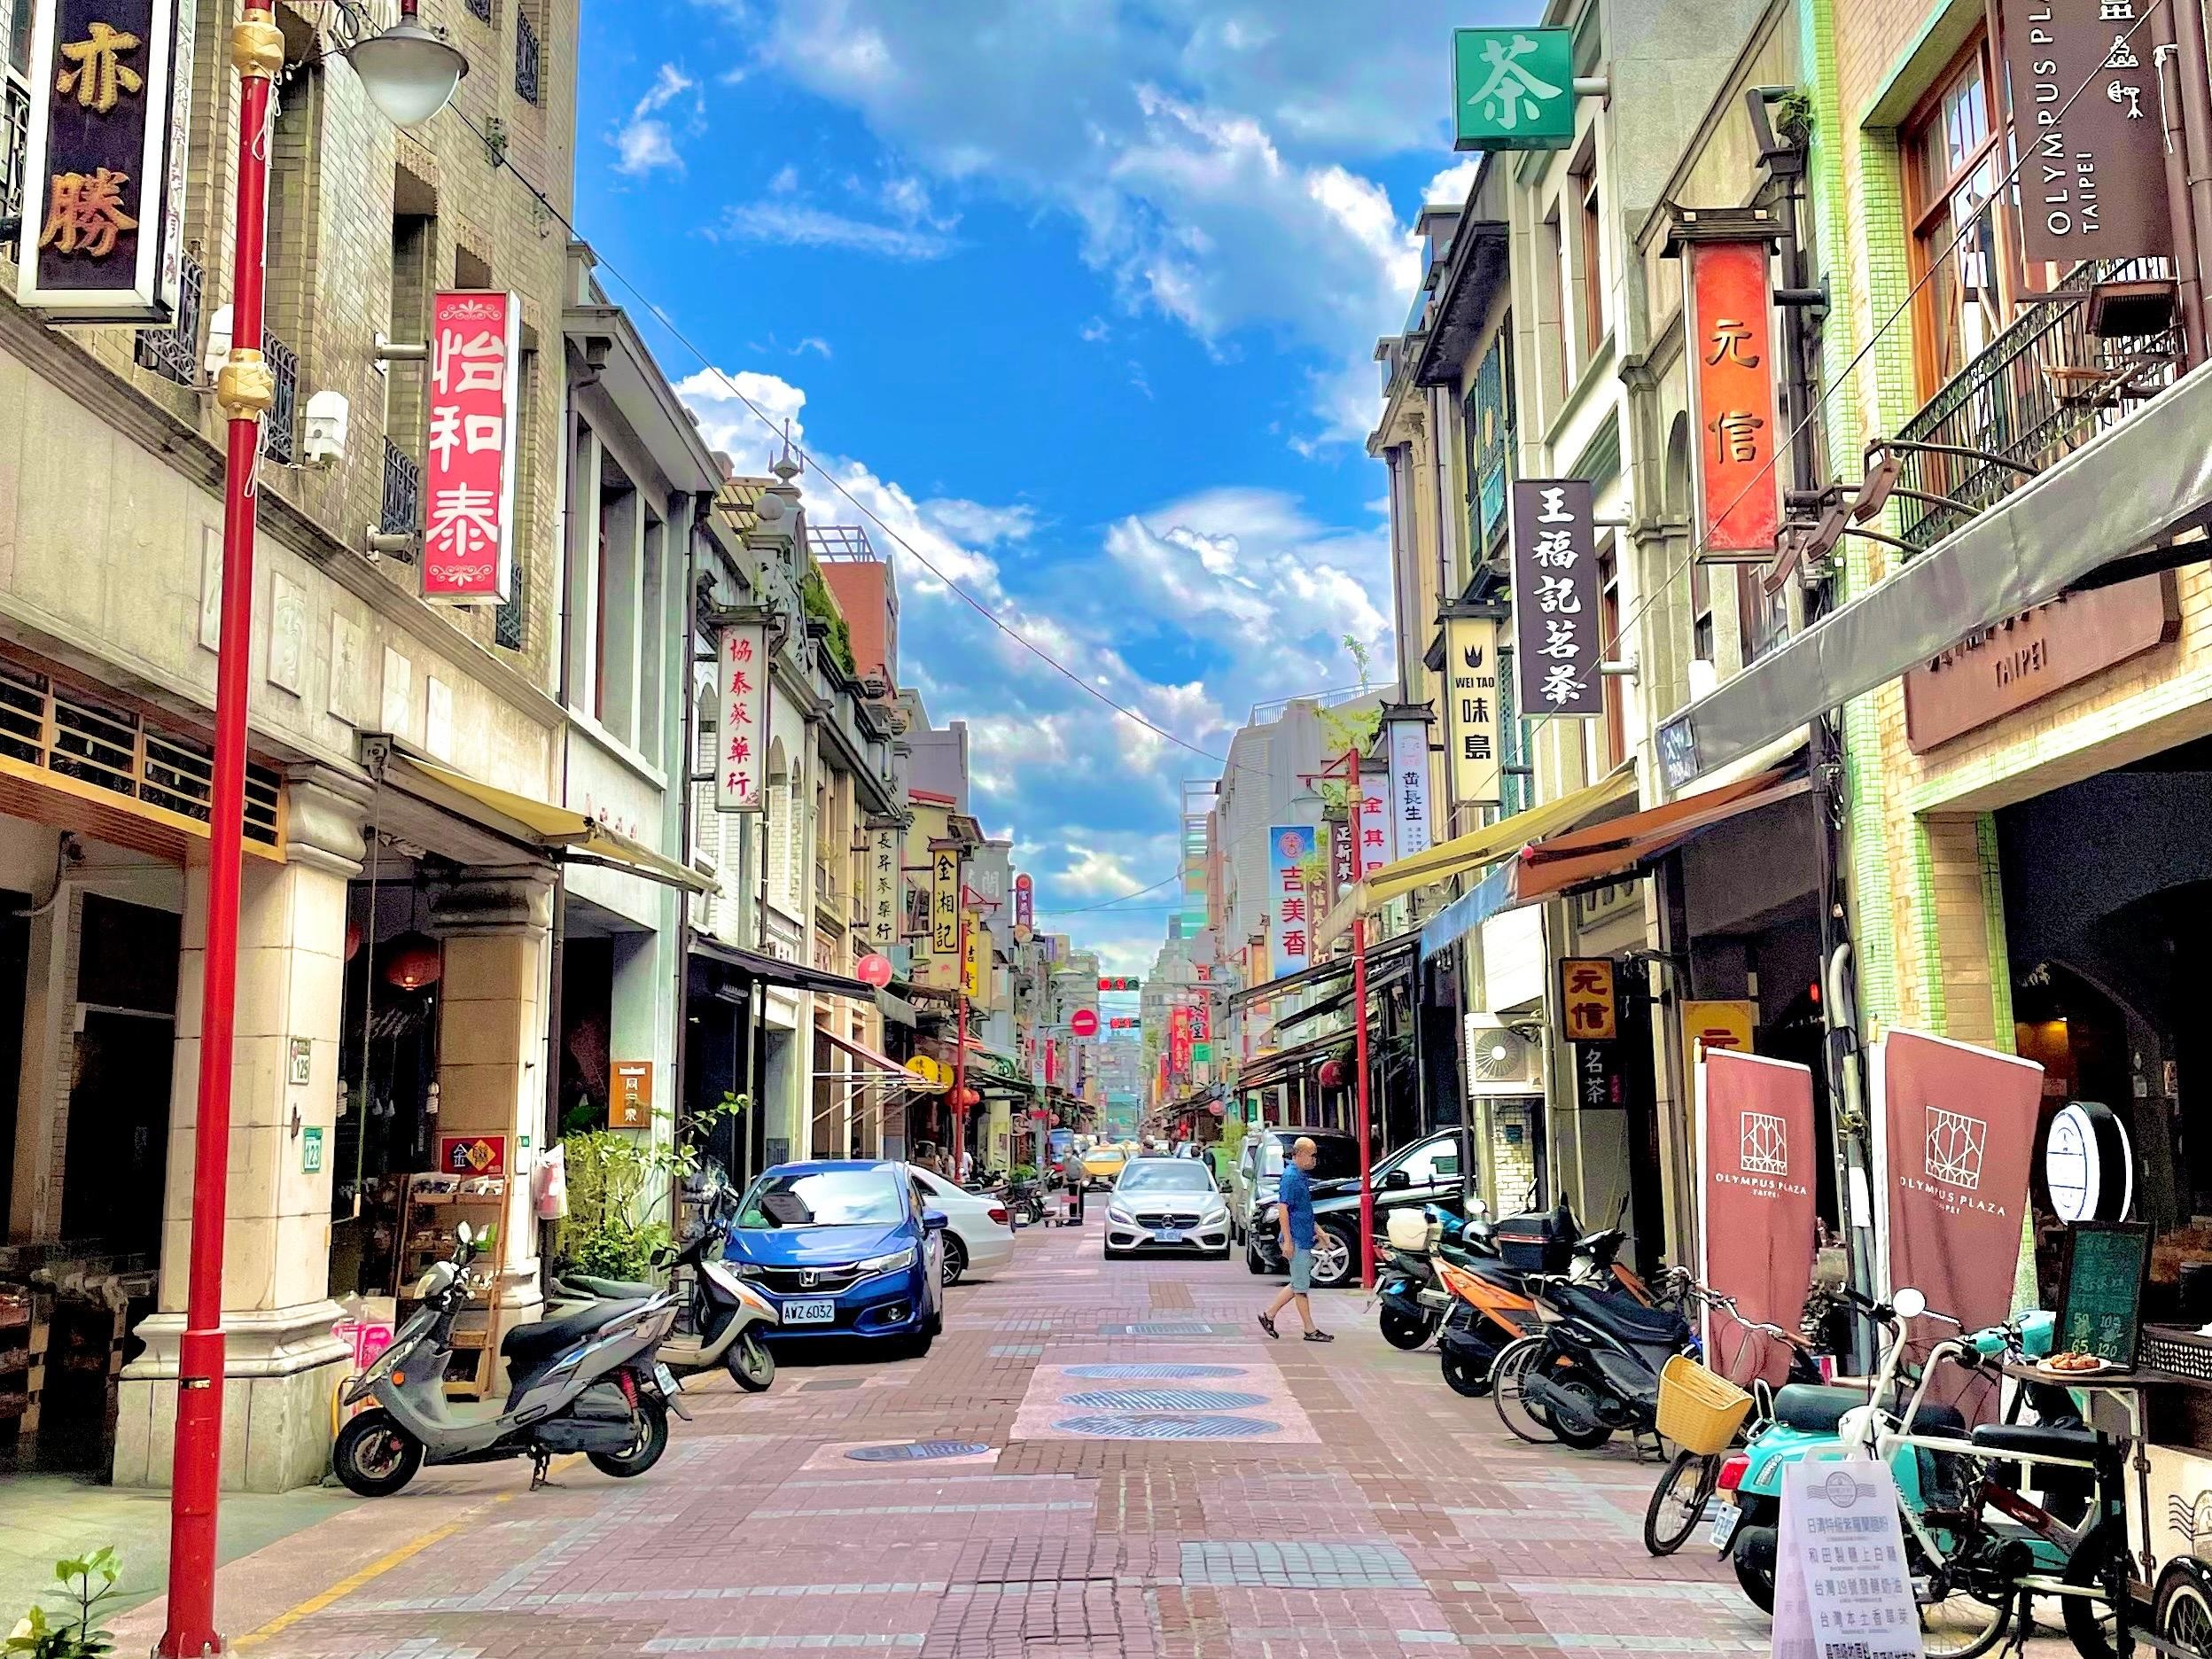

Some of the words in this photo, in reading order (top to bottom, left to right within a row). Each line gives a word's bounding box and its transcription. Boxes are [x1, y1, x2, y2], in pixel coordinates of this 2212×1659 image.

[1468, 35, 1562, 130] 茶
[38, 22, 144, 257] 亦勝
[2033, 58, 2072, 236] OLYMPUS
[2076, 152, 2099, 234] TAIPEI
[1706, 319, 1764, 464] 元信
[426, 329, 504, 557] 怡和泰
[1532, 487, 1588, 705] 王福記茗茶
[1455, 677, 1474, 688] WEI
[1476, 676, 1495, 688] TAO
[1994, 638, 2047, 689] TAIPEI
[1462, 697, 1491, 759] 味島
[936, 854, 955, 948] 金湘記
[1280, 866, 1306, 956] 吉美香
[1569, 970, 1609, 1030] 元信
[1585, 1048, 1606, 1104] 名茶
[1715, 1172, 1775, 1189] OLYMPUS
[1778, 1181, 1807, 1196] PLAZA
[1959, 1196, 2006, 1217] PLAZA
